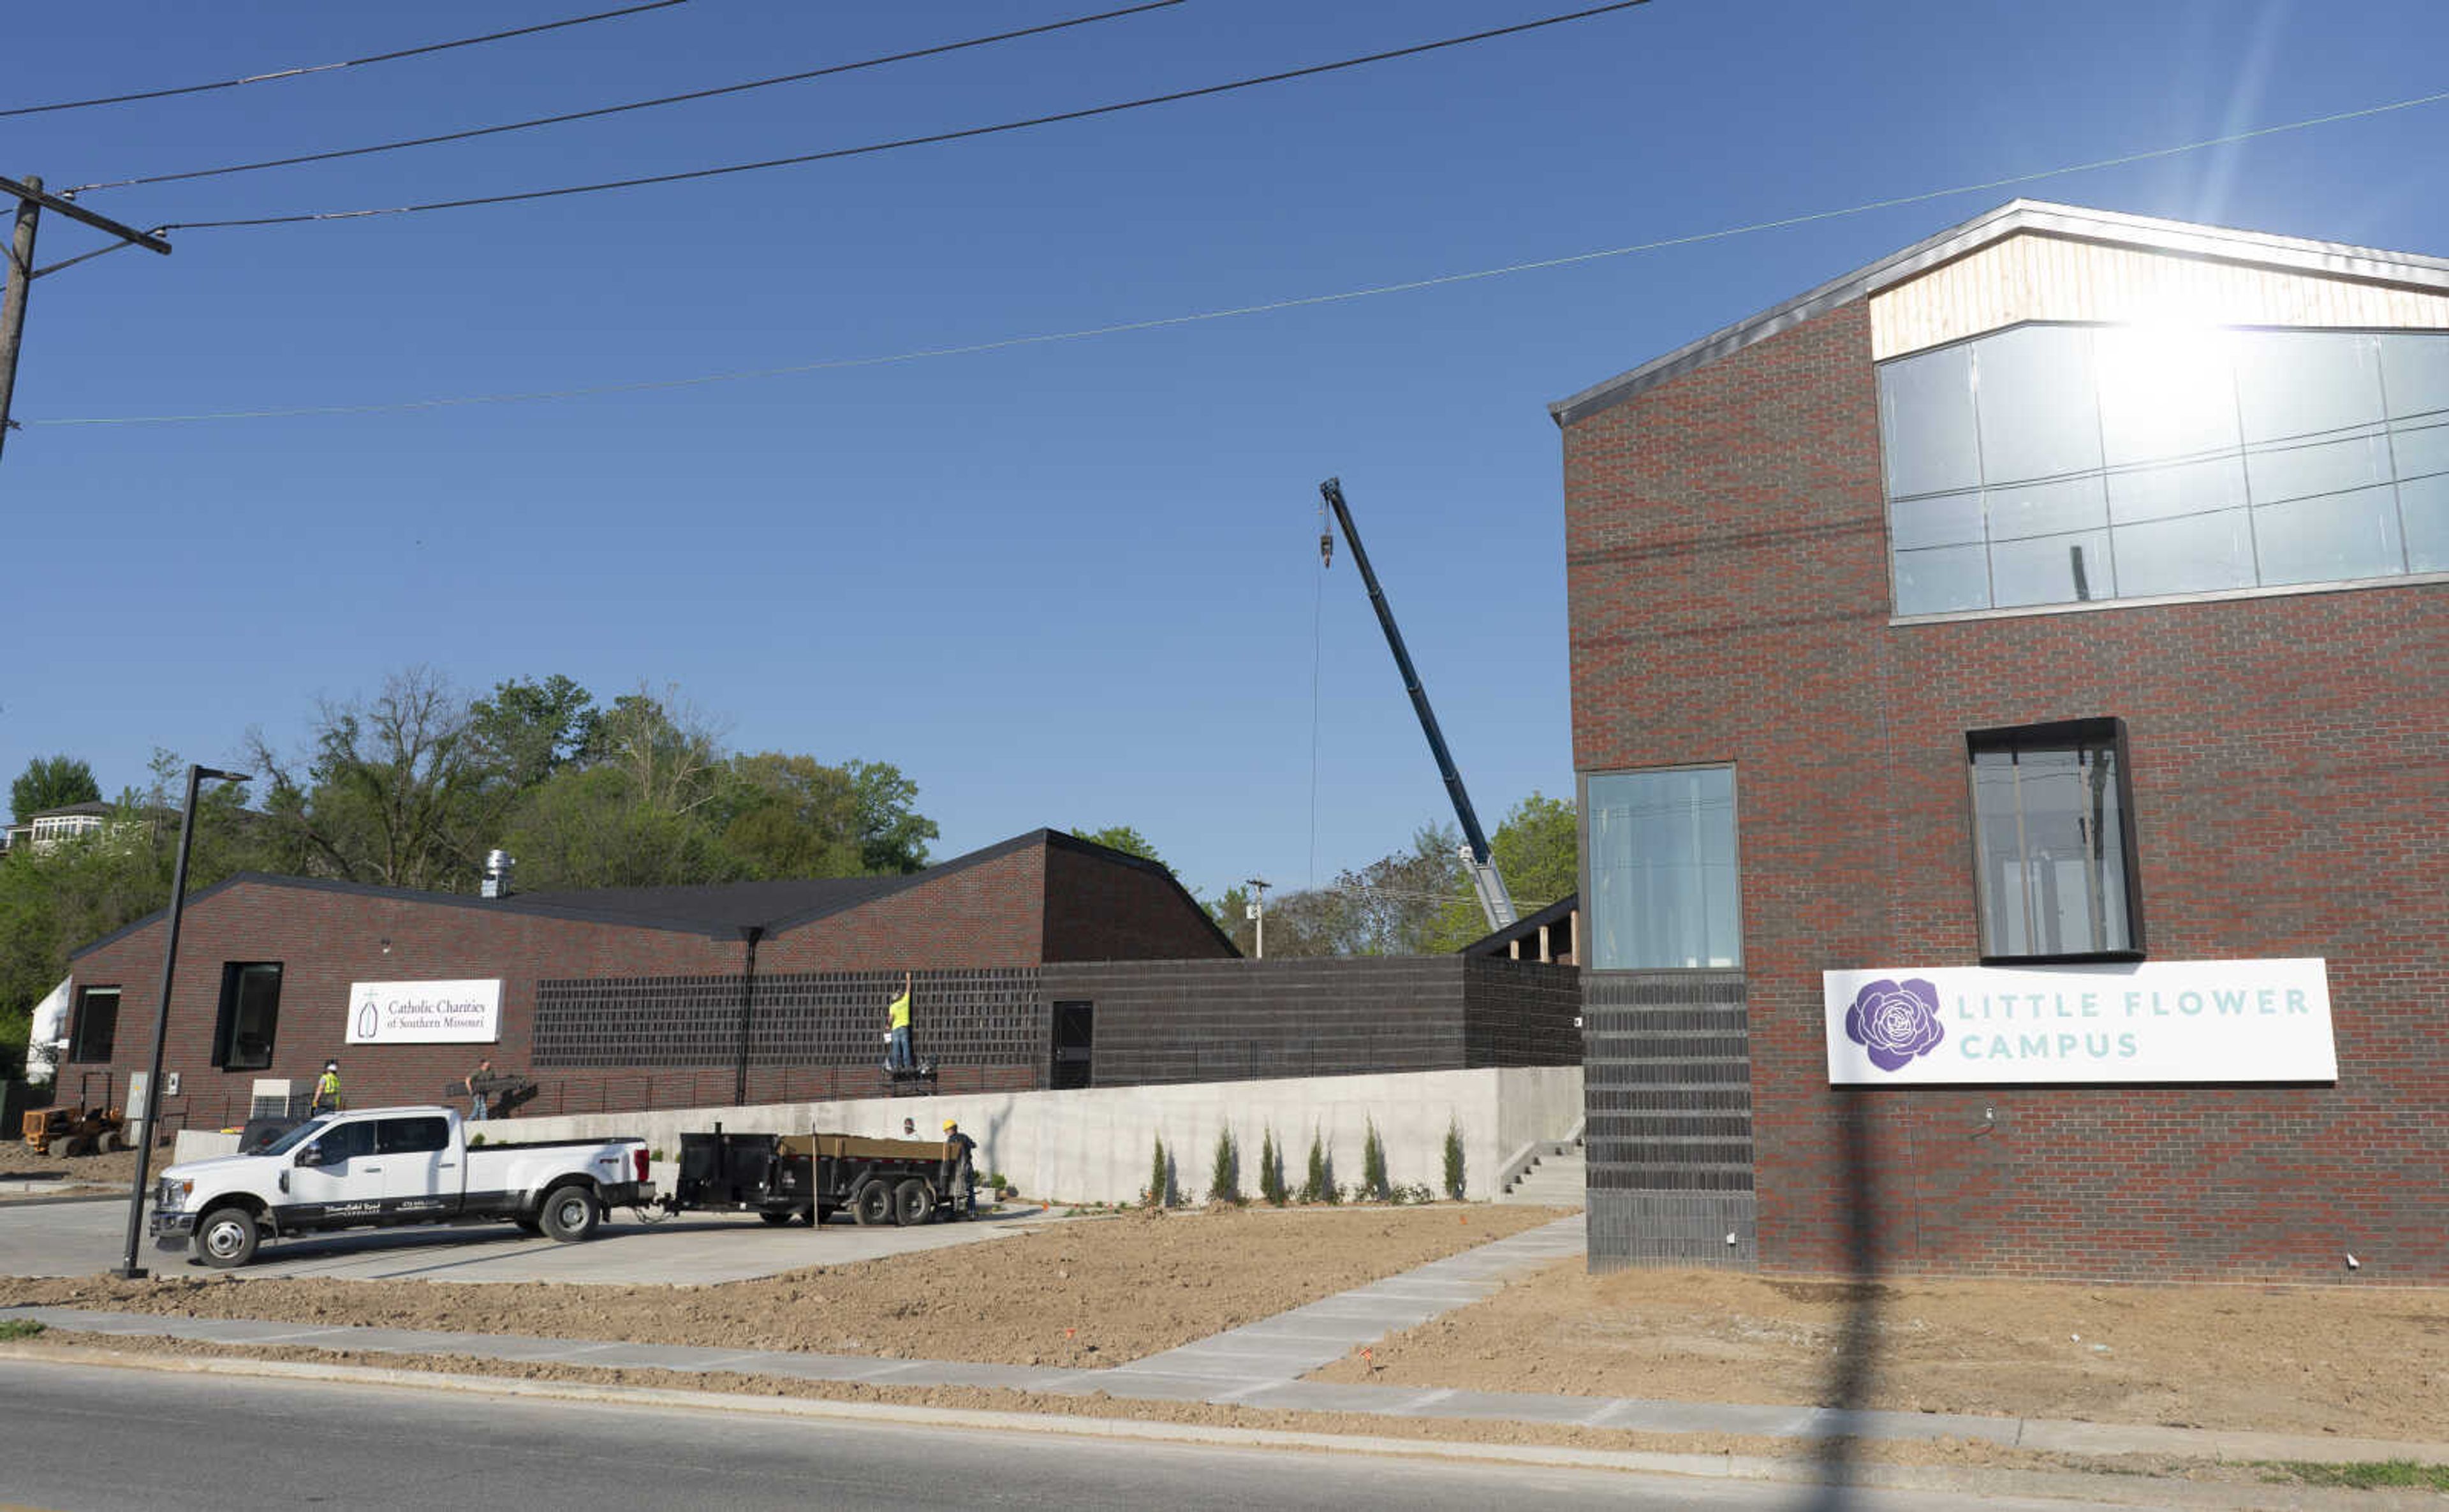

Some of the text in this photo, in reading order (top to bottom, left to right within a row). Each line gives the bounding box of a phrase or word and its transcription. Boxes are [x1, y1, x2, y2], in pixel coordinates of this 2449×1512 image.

[388, 998, 485, 1015] Catholic Charities
[1958, 989, 2309, 1018] LITTLE FLOWER
[388, 1016, 484, 1028] of Southern Missouri
[1959, 1032, 2138, 1059] CAMPUS
